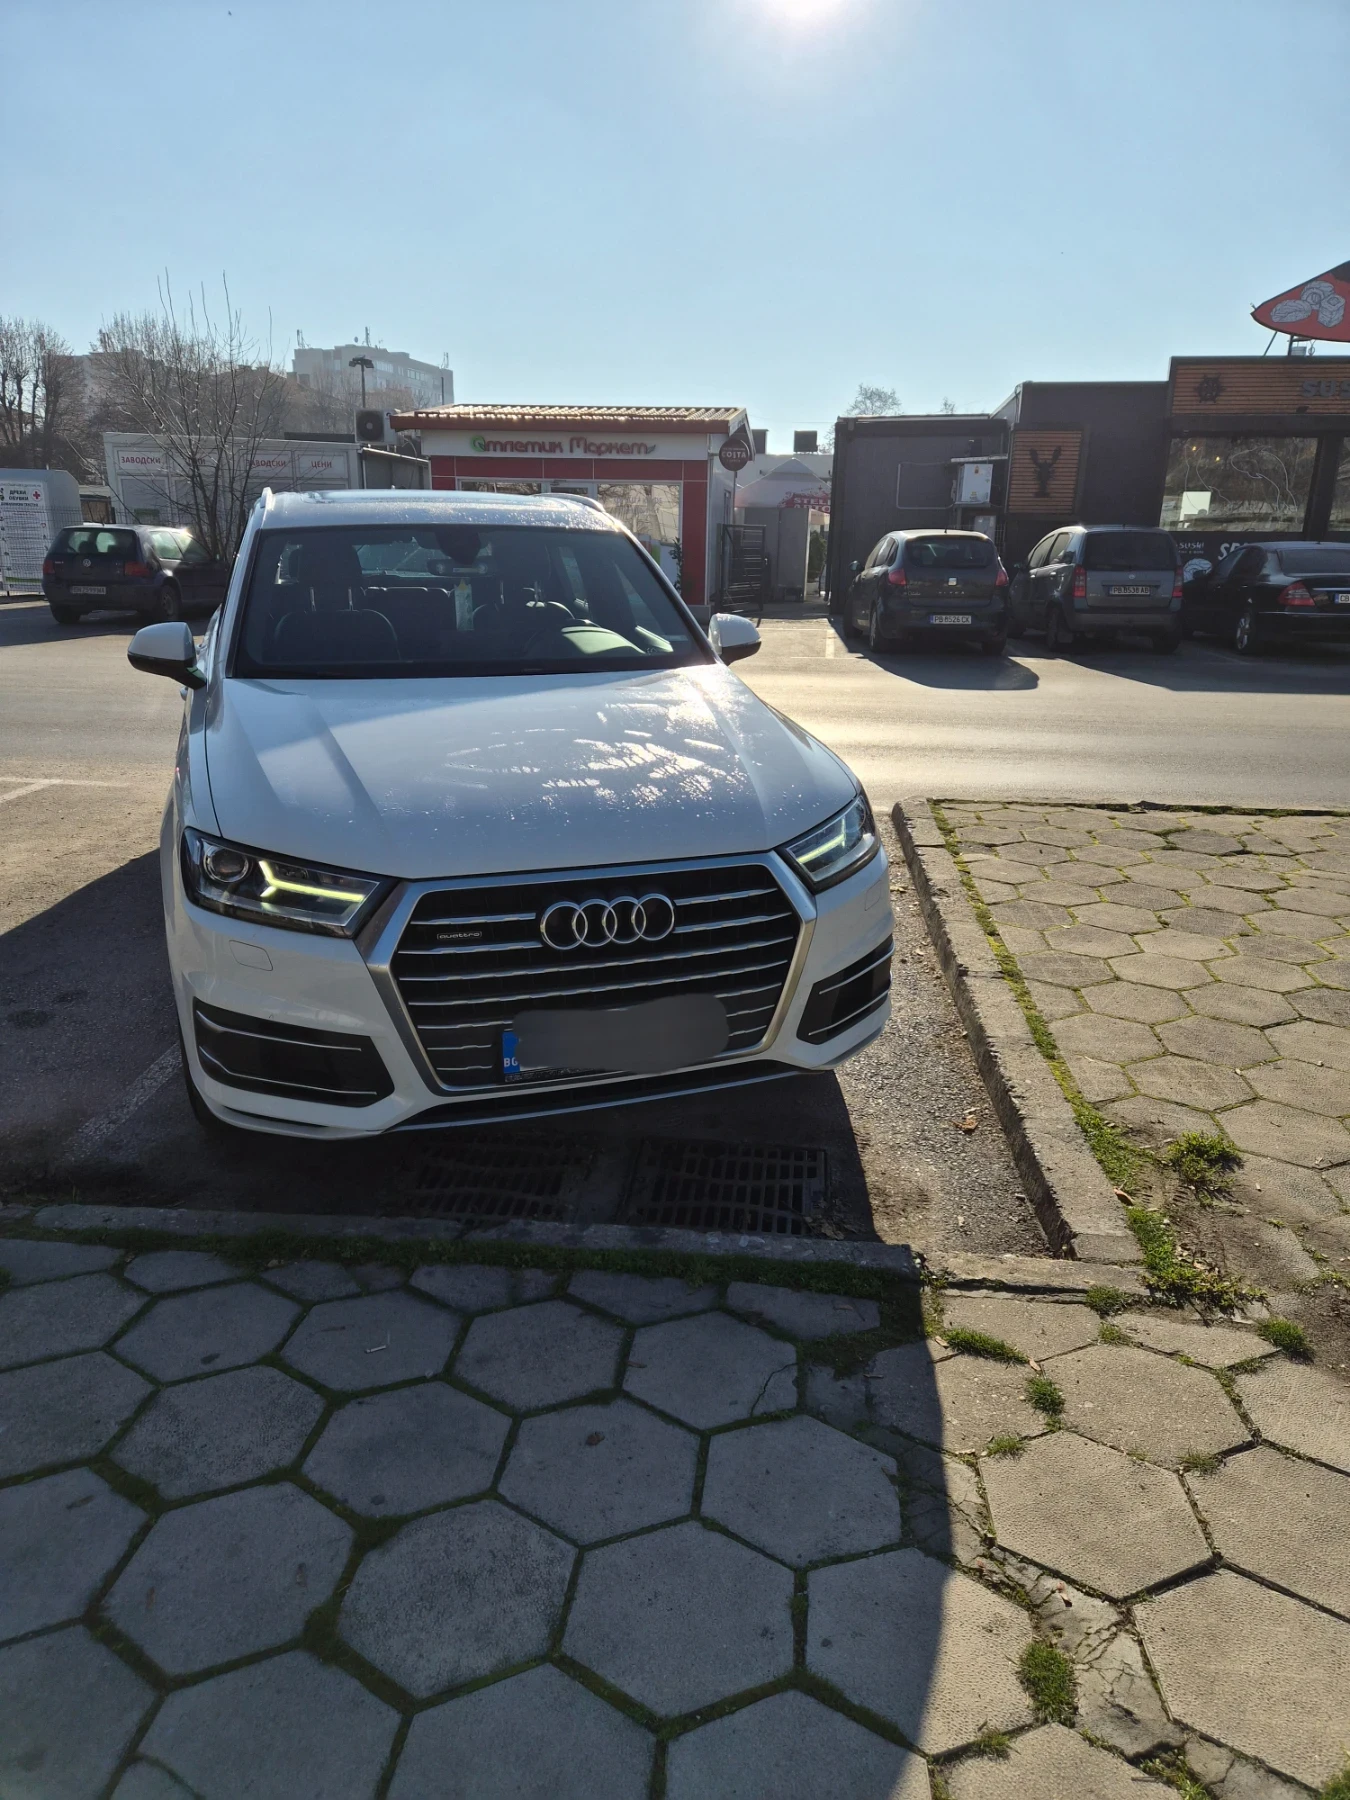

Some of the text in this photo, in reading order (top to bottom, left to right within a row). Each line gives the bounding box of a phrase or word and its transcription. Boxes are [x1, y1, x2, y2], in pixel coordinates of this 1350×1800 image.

[721, 451, 747, 459] COSTA
[121, 456, 161, 465] ЗАВОДСКИ
[311, 460, 332, 469] ЦЕНИ
[439, 931, 480, 939] quattro
